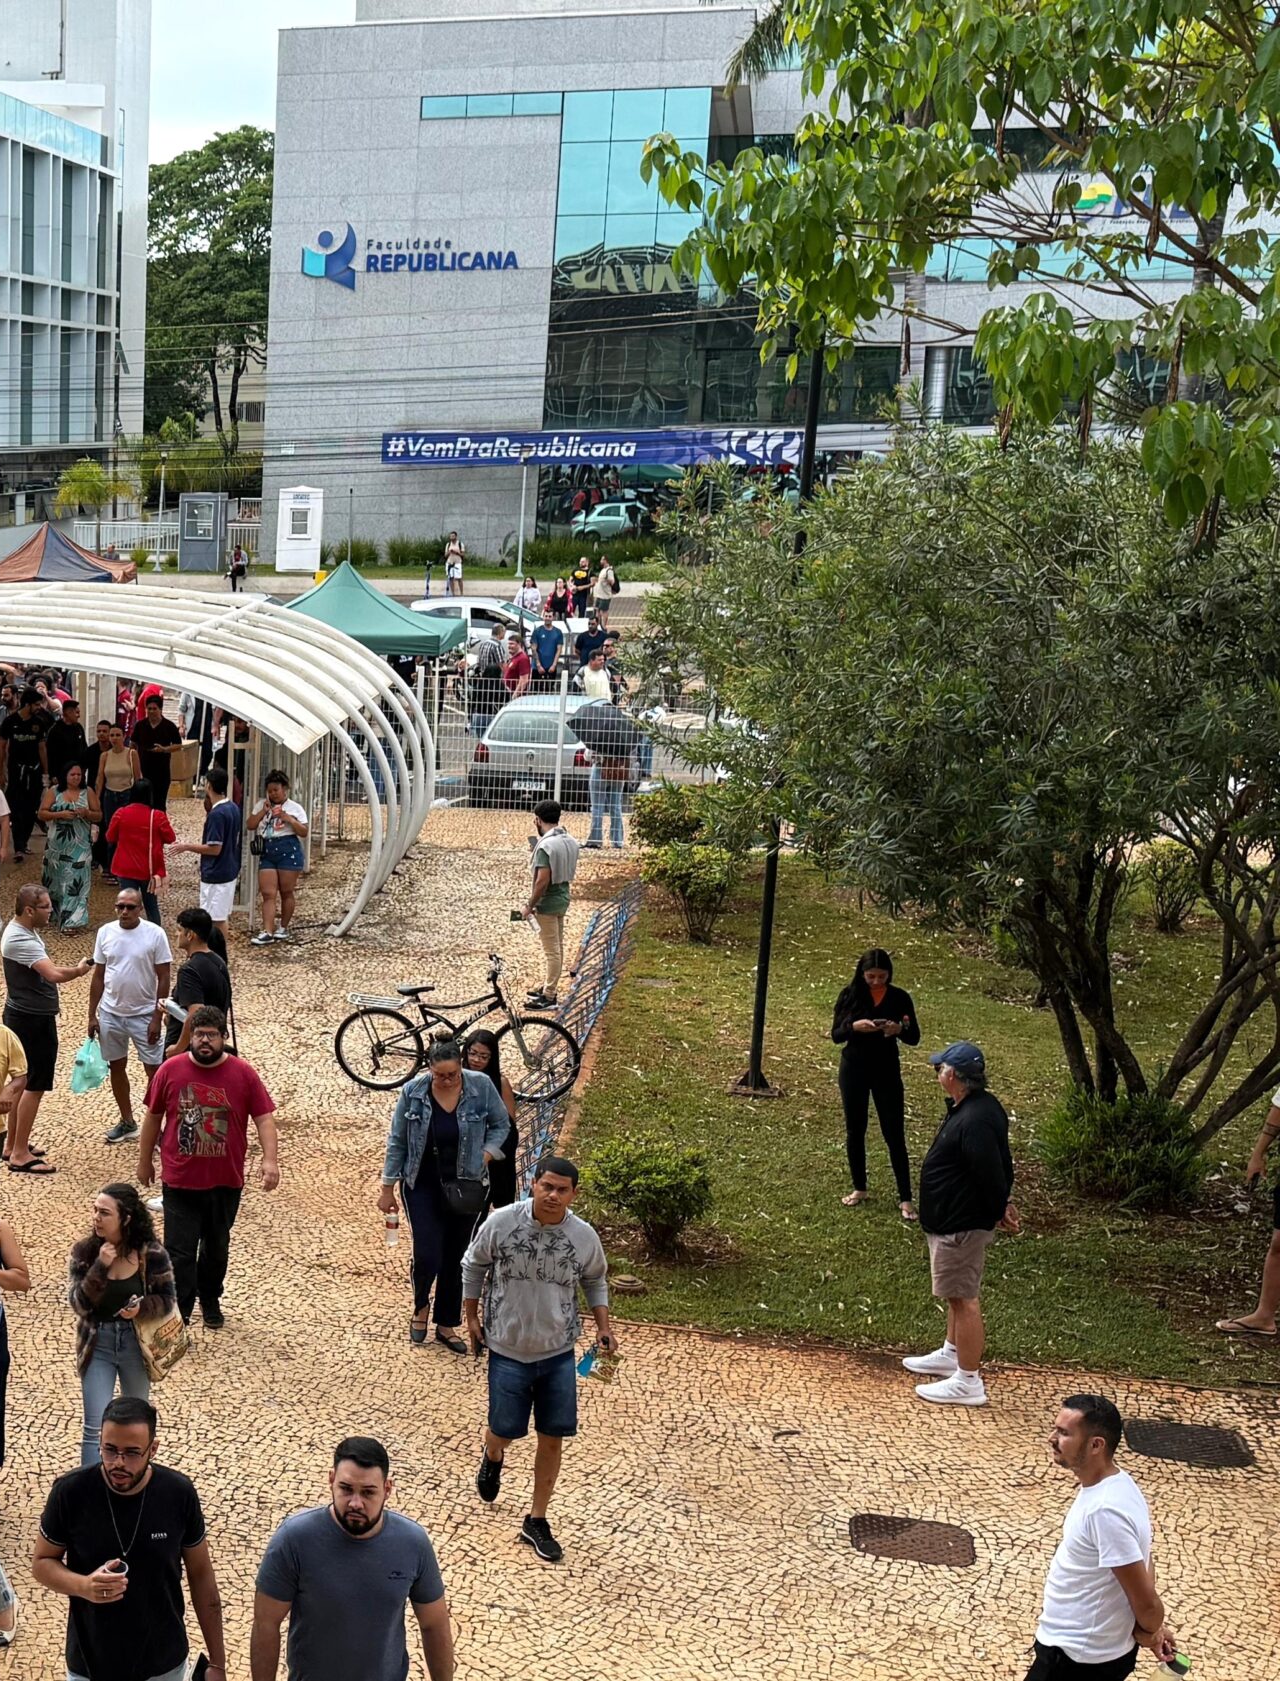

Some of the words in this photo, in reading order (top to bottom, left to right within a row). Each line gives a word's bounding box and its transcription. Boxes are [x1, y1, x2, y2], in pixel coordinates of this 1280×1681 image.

[366, 237, 452, 251] Faculdade
[365, 250, 519, 273] REPUBLICANA
[386, 436, 637, 460] #VemPraRepublicana
[466, 1006, 489, 1024] CALOI
